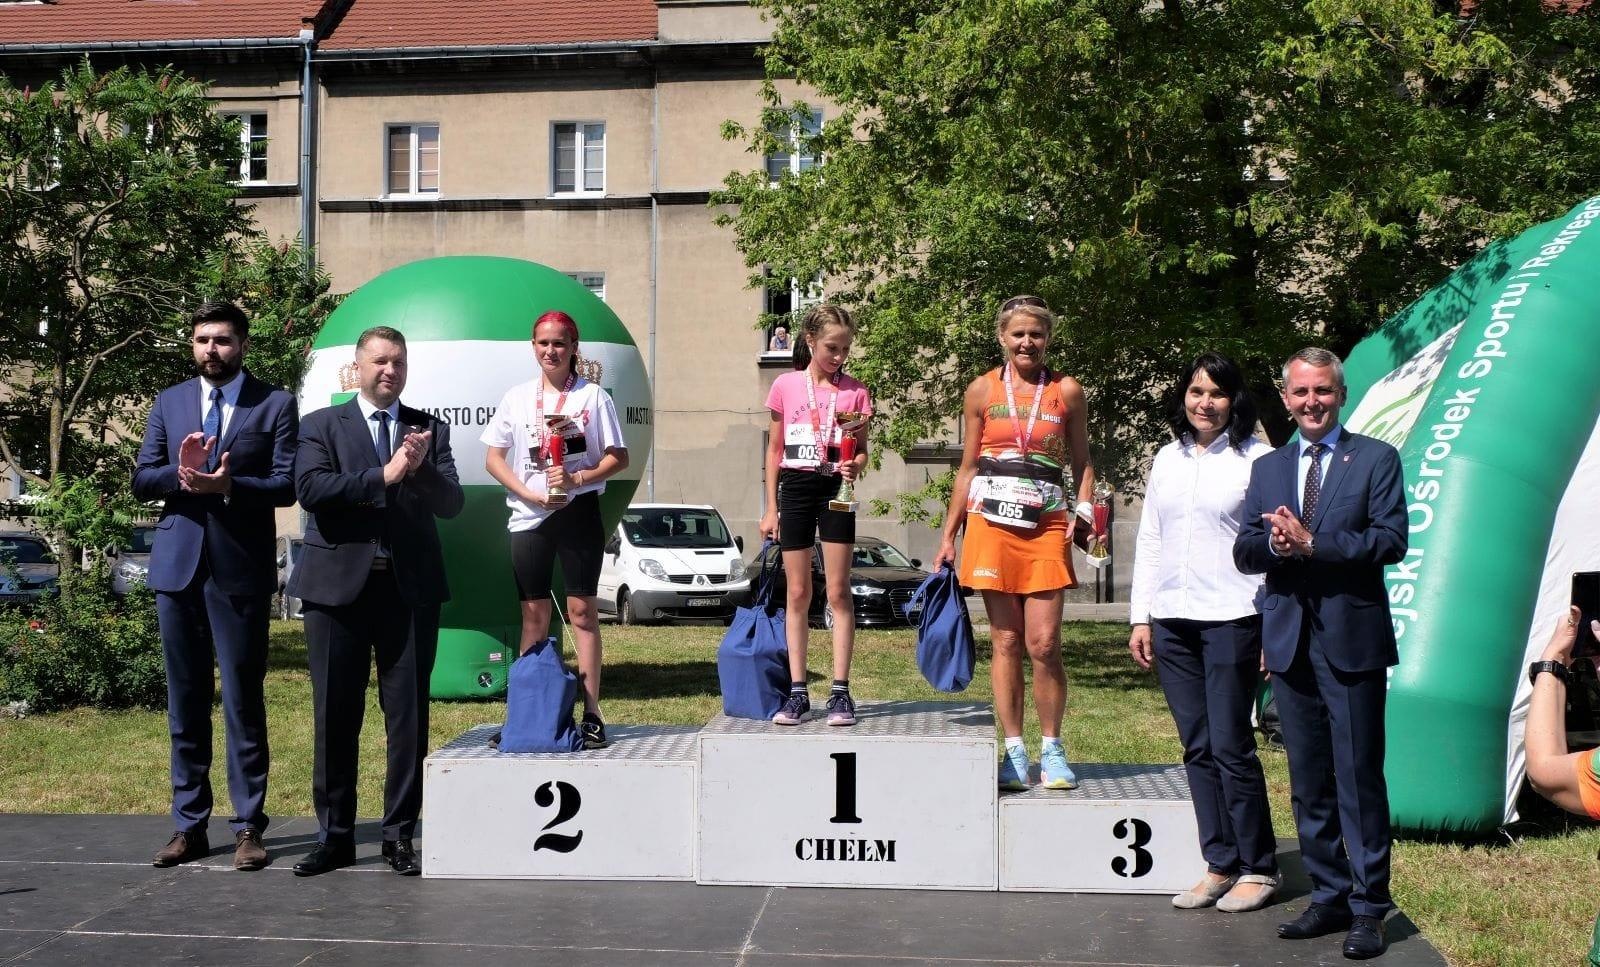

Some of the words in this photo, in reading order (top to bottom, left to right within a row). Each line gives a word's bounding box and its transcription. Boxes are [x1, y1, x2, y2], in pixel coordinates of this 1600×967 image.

[422, 407, 471, 426] ASTO
[998, 501, 1024, 519] 055
[1386, 548, 1425, 690] ejski
[1407, 387, 1481, 534] Ośrodek
[1458, 282, 1531, 379] Sportu
[1509, 271, 1541, 281] i
[532, 780, 584, 854] 2
[828, 752, 862, 824] 1
[1110, 817, 1154, 879] 3
